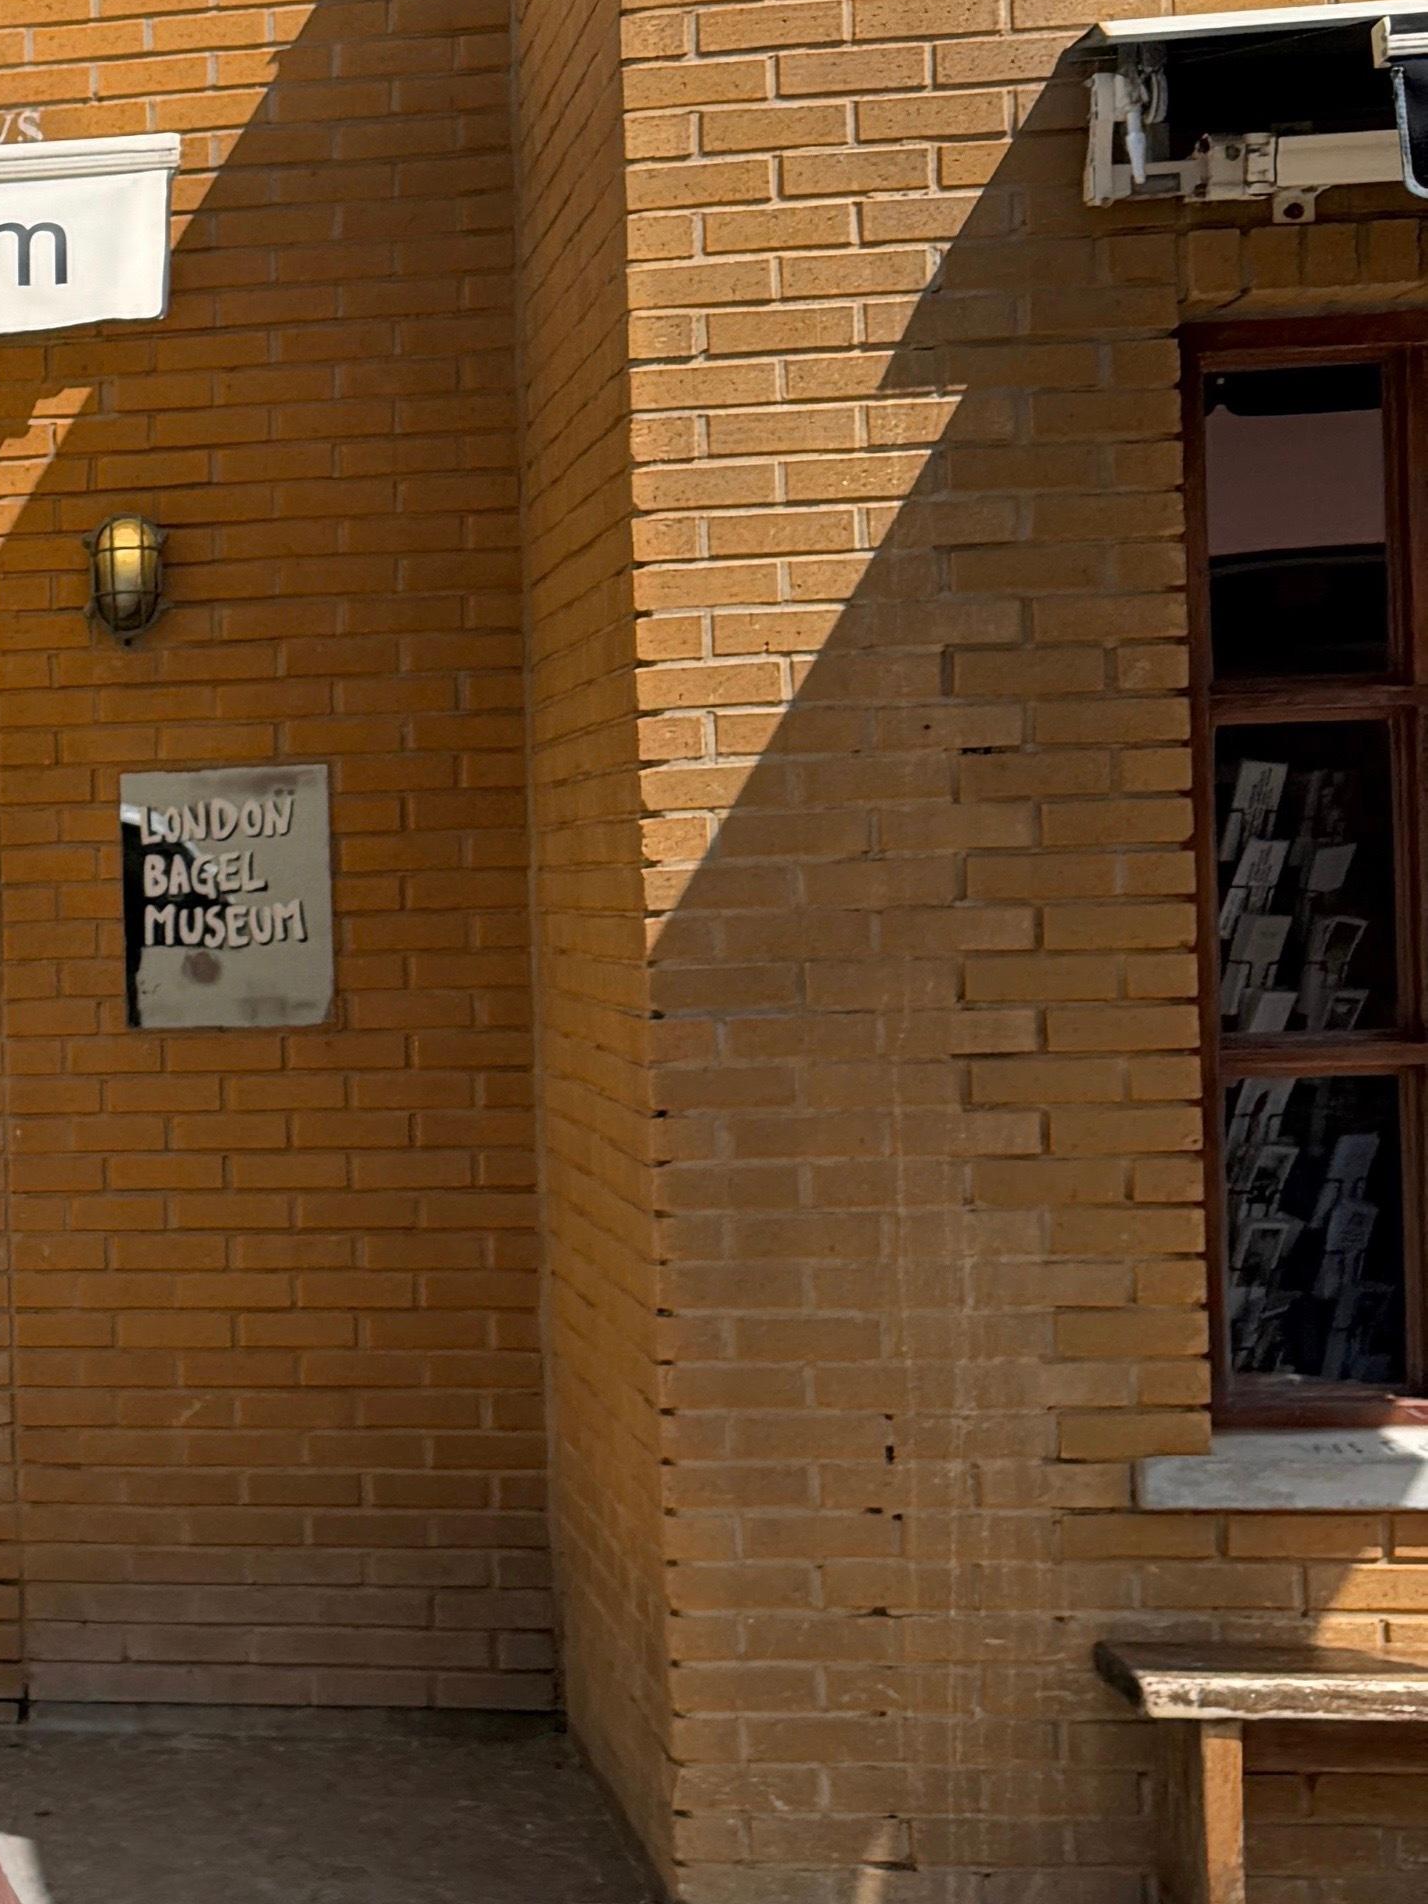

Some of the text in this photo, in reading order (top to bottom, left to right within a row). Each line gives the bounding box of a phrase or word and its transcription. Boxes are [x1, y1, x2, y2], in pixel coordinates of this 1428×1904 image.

[140, 797, 294, 845] LONDON
[144, 851, 268, 899] BAGEL
[144, 899, 308, 948] MUSEUM
